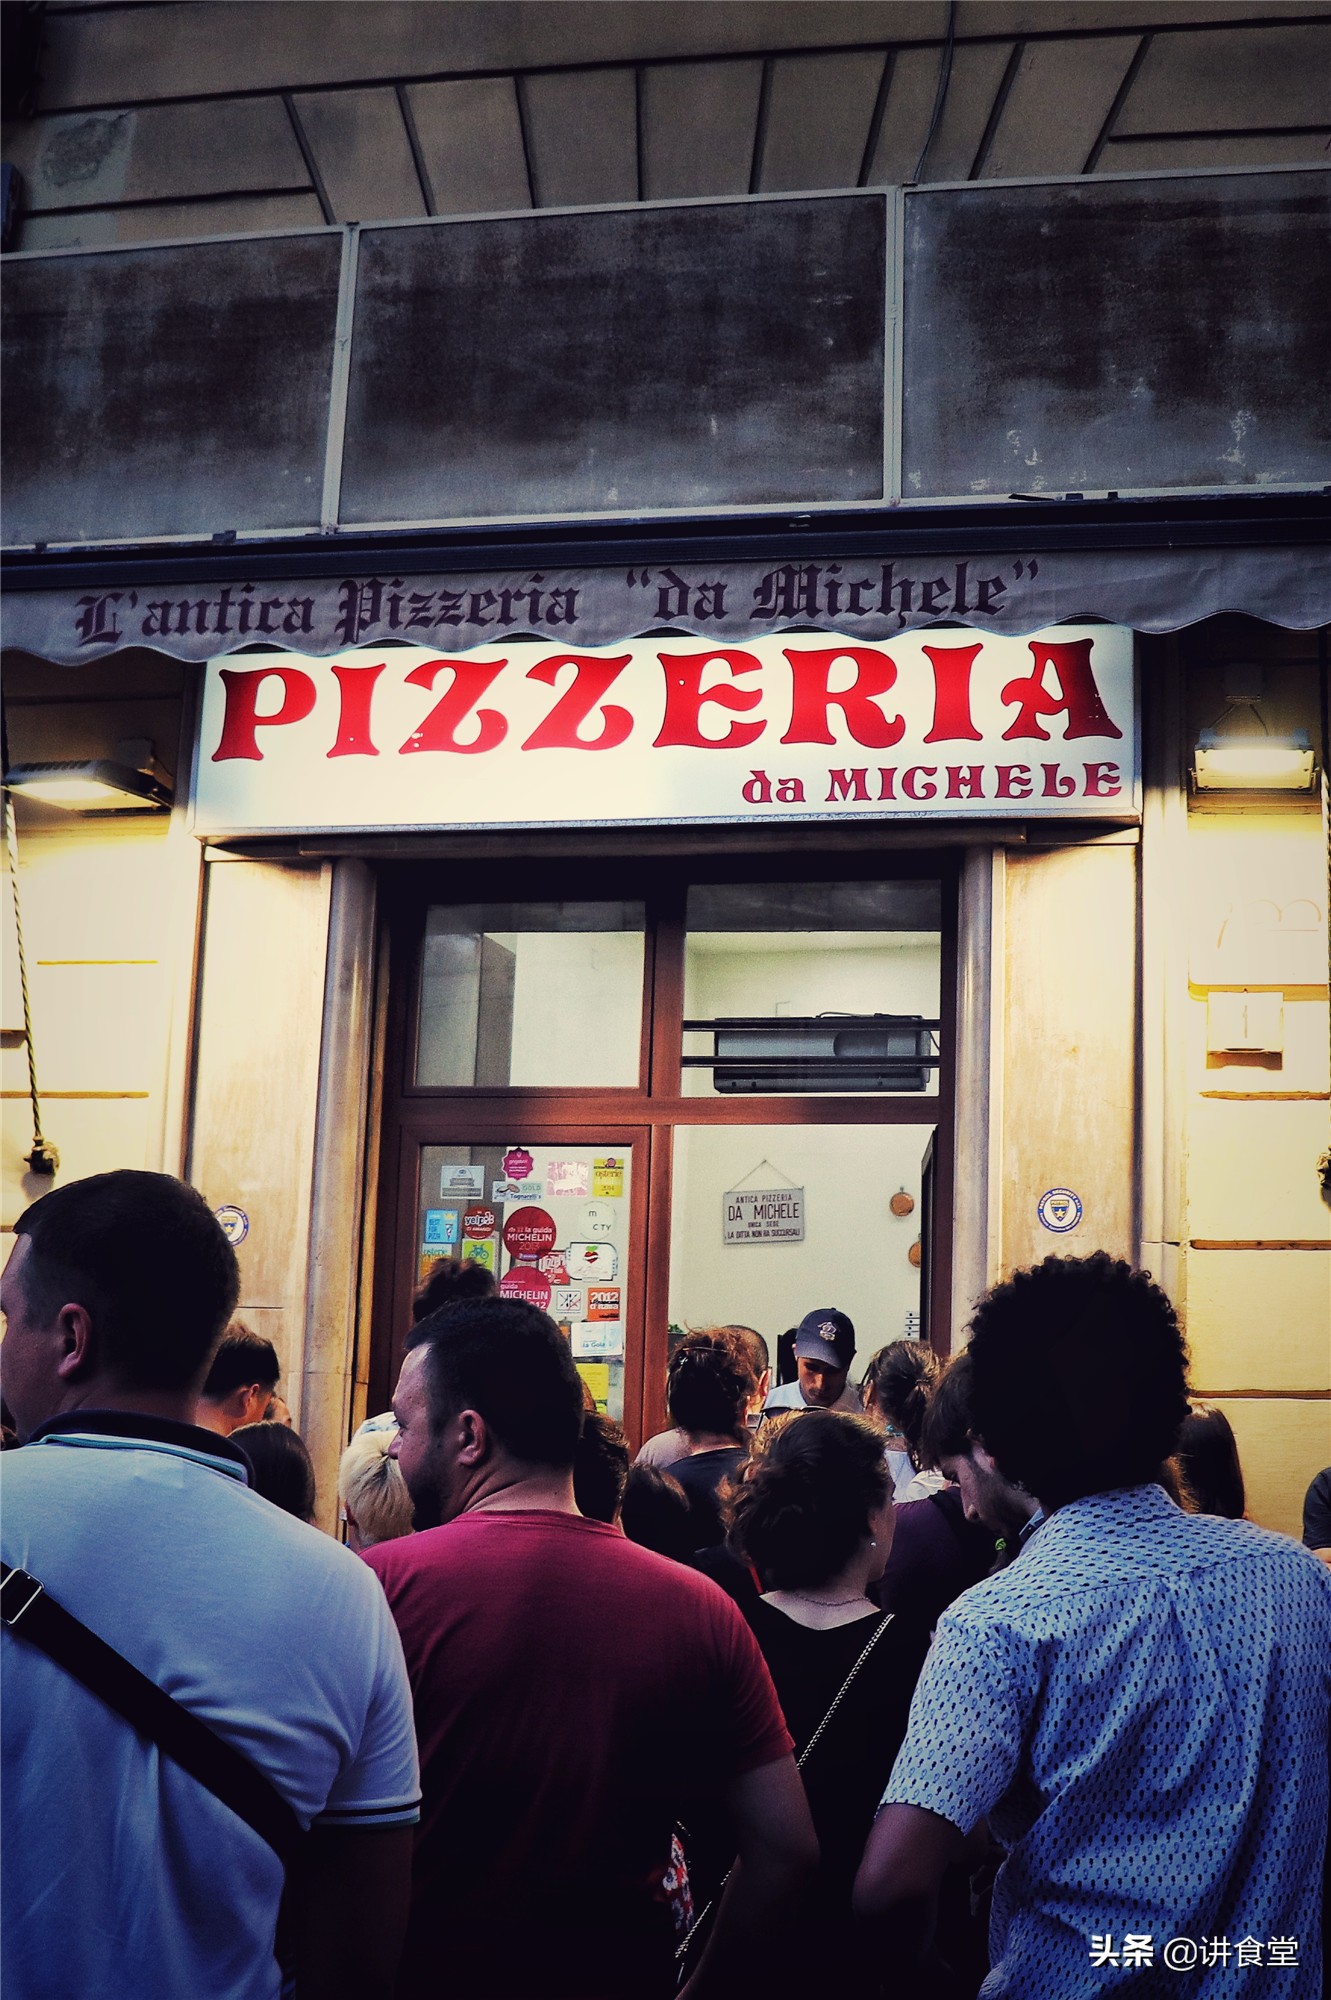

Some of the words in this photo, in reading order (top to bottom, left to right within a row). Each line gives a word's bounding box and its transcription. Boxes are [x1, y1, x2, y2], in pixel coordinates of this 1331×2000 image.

[75, 581, 317, 646] L'antica
[334, 573, 581, 645] Pizzeria
[211, 638, 1123, 762] PIZZERIA
[741, 769, 805, 804] da
[824, 761, 1123, 803] MICHELE
[735, 1195, 759, 1204] ANTICA
[761, 1193, 793, 1203] PIZZERIA
[728, 1205, 743, 1221] DA
[753, 1202, 800, 1220] MICHELE
[464, 1215, 486, 1227] yelp
[532, 1226, 553, 1235] guida
[507, 1233, 553, 1242] MICHELIN
[499, 1290, 549, 1300] MICHELIN
[590, 1292, 619, 1303] 2012
